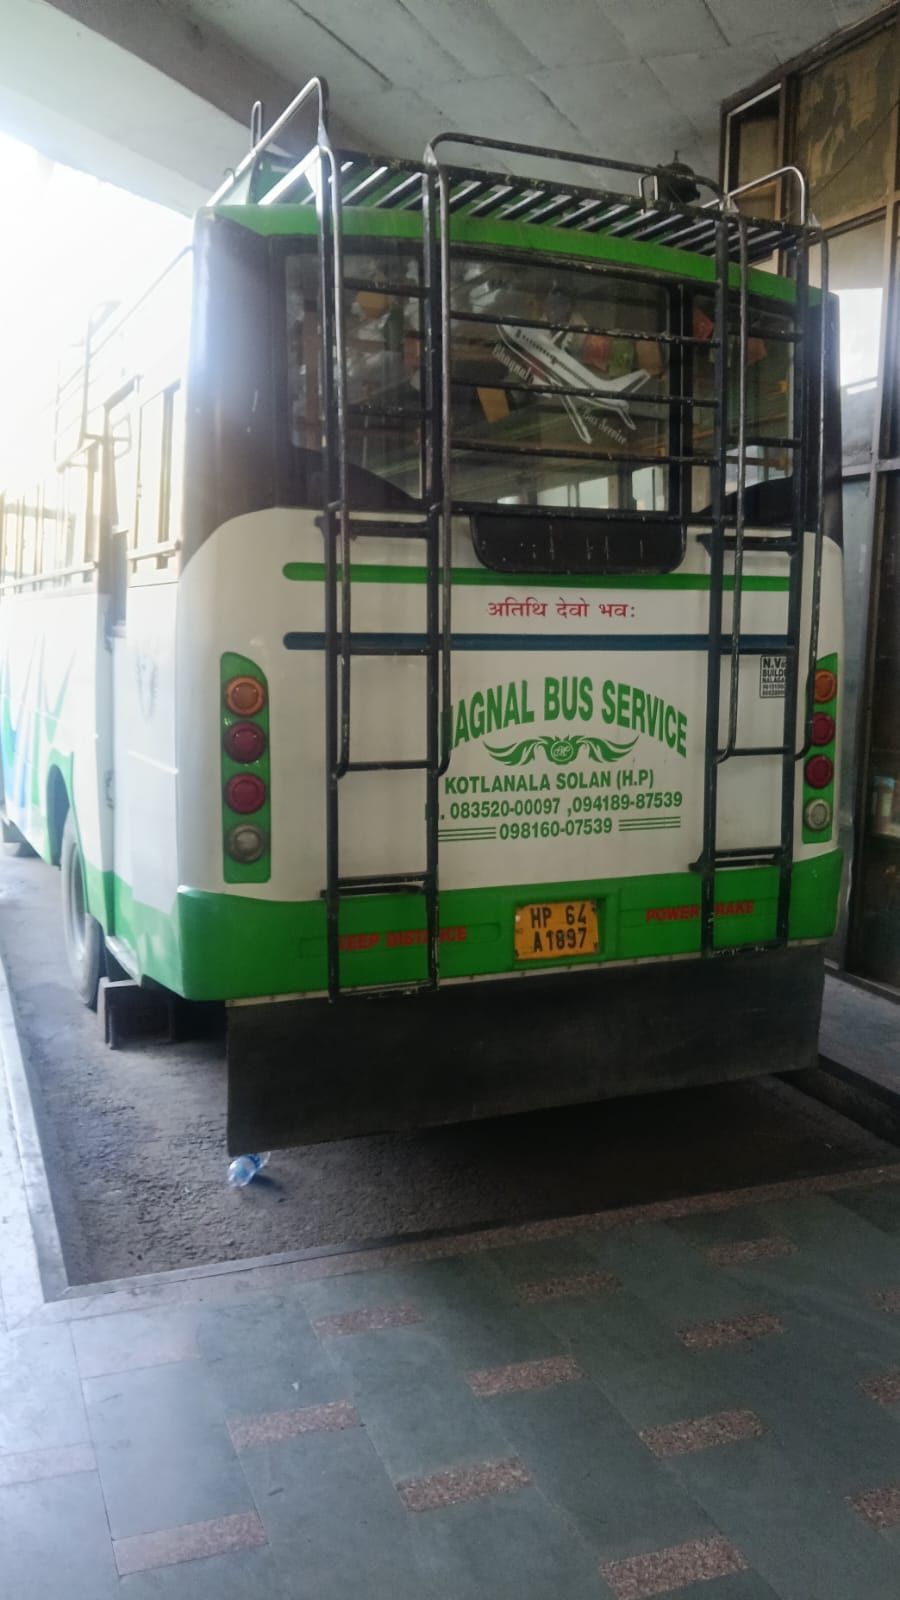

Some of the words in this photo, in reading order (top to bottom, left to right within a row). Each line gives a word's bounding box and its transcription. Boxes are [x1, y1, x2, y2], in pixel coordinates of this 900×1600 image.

[489, 597, 548, 617] अतिथि
[556, 597, 590, 618] देवो
[544, 676, 593, 721] BUS
[601, 680, 687, 758] SERVICE
[445, 774, 550, 794] KOTLANALA
[556, 771, 611, 790] SOLAN
[616, 769, 654, 791] (H.P)
[451, 798, 560, 820] 083520-00097
[499, 817, 613, 840] 098160-07539
[530, 906, 552, 929] HP
[565, 904, 587, 925] 64
[646, 905, 700, 922] POWER
[714, 901, 754, 916] RAKE
[533, 927, 587, 952] A1897
